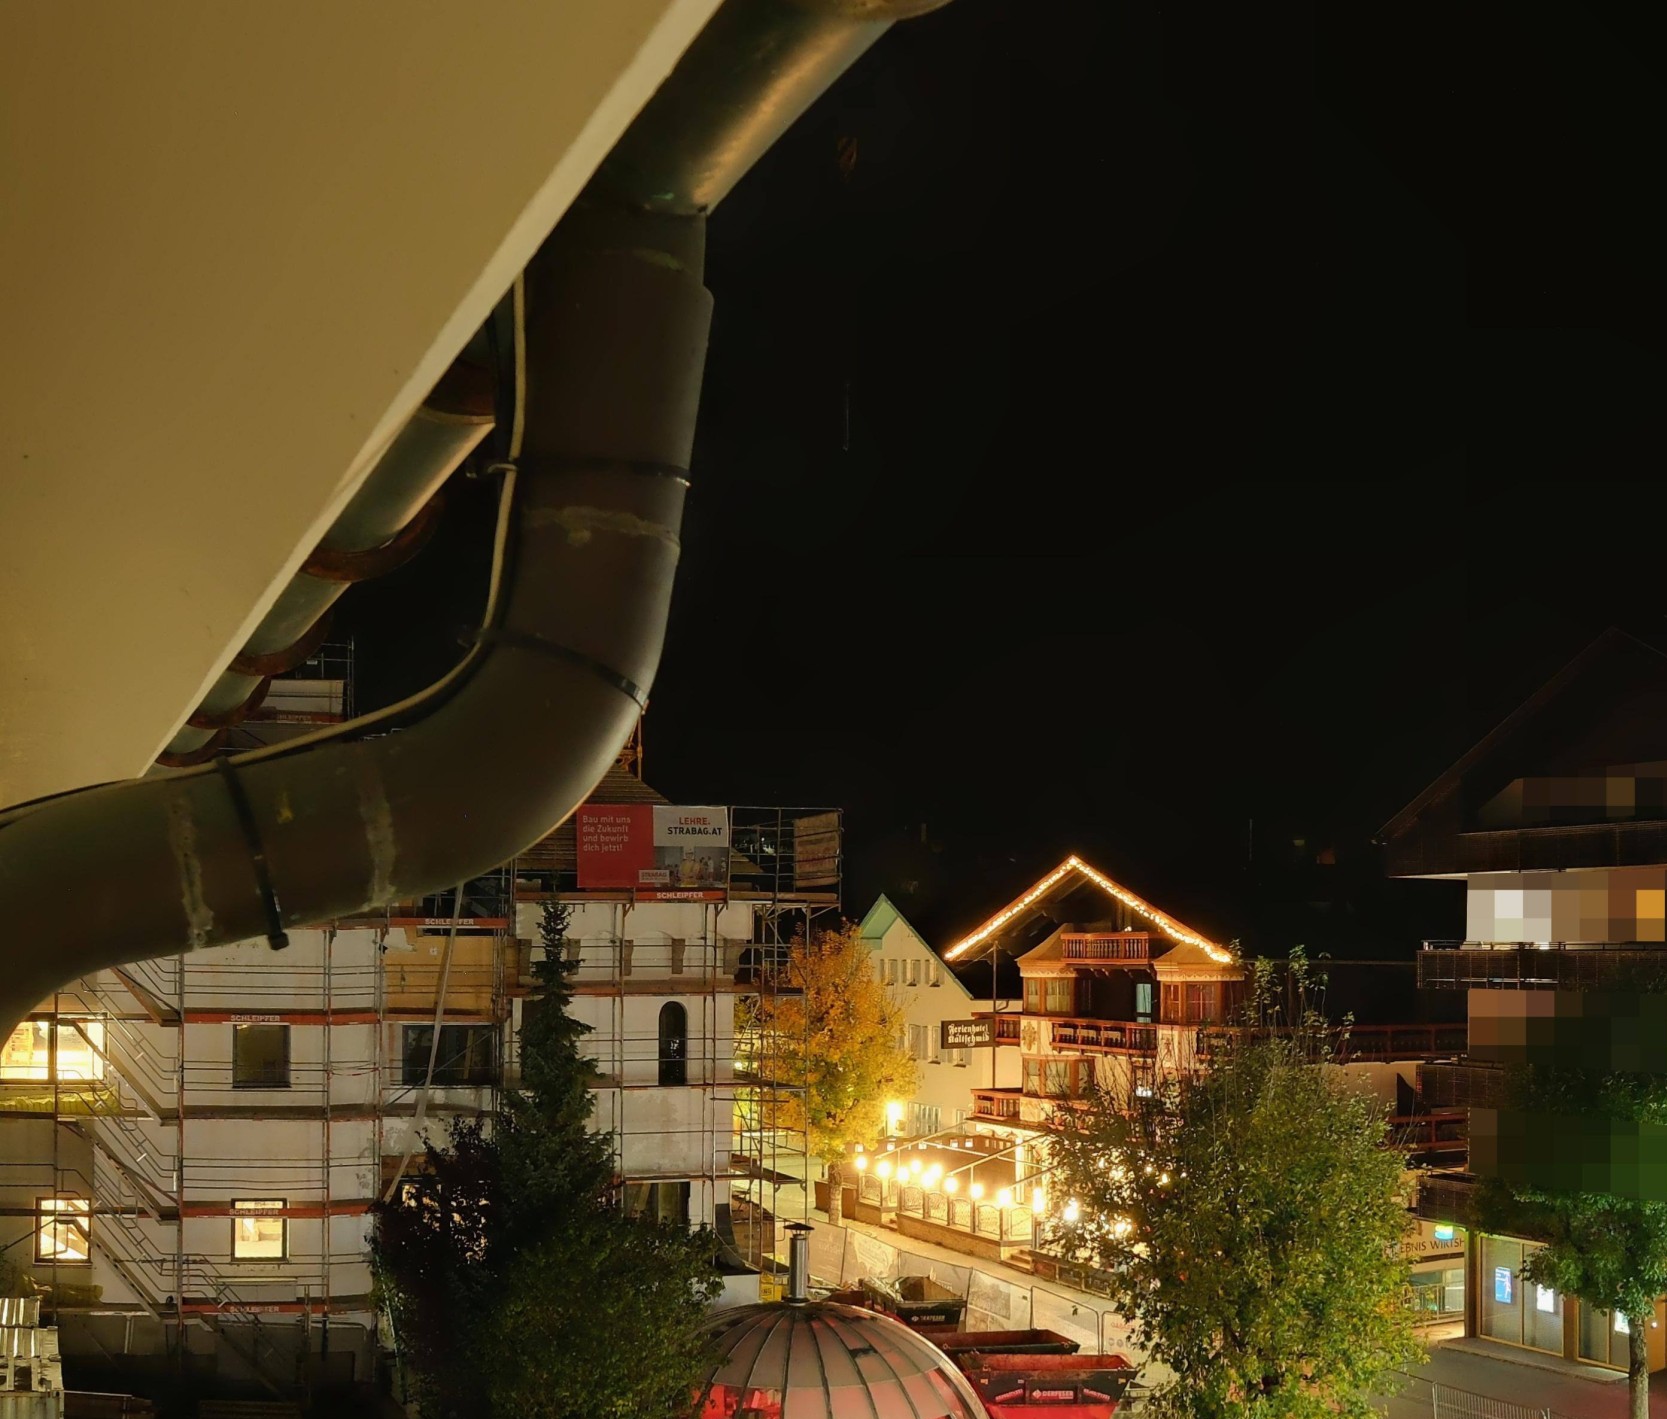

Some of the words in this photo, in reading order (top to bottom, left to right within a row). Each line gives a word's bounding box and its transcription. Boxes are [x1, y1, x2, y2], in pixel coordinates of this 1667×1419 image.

[582, 815, 599, 824] Bau
[600, 815, 614, 824] mit
[678, 817, 711, 826] LEHRE.
[582, 825, 596, 833] die
[597, 825, 629, 833] Zukunft
[667, 827, 722, 836] STRABAG.AT
[582, 834, 598, 842] und
[600, 834, 629, 842] bewirb
[582, 843, 599, 852] dich
[600, 843, 623, 854] jetzt!
[656, 891, 704, 899] SCHLEIPFER
[425, 918, 474, 926] SCHLEFER
[229, 1208, 279, 1216] SCHLEIPFER
